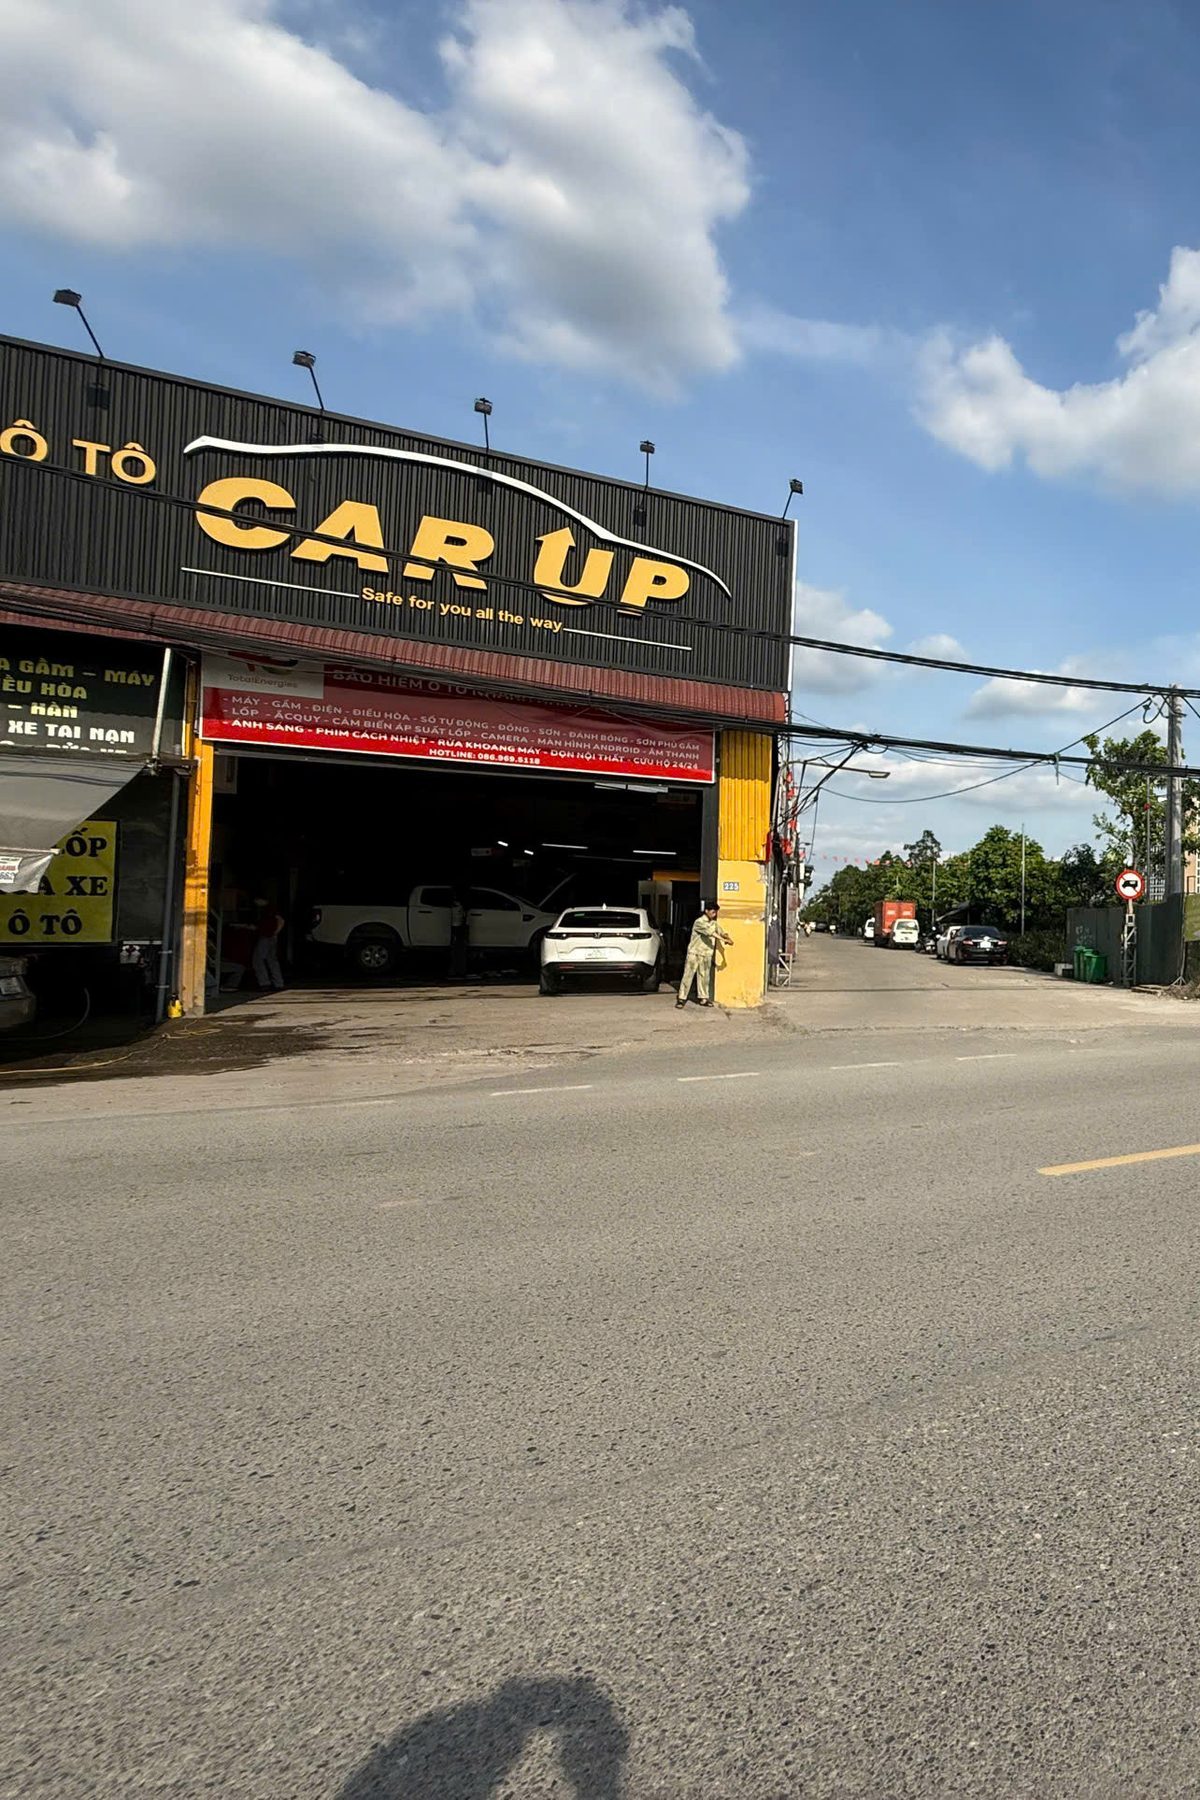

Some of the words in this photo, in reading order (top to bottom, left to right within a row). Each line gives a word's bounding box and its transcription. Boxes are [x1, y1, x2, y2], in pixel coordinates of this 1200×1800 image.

[0, 419, 48, 462] Ô
[72, 439, 157, 485] TÔ
[195, 476, 495, 591] CAR
[533, 526, 691, 617] UP
[361, 587, 403, 606] Safe
[408, 595, 435, 610] for
[439, 602, 472, 617] you
[475, 607, 494, 621] all
[497, 610, 524, 626] the
[529, 616, 563, 633] way
[18, 657, 75, 678] GẦM
[104, 669, 156, 687] MÁY
[40, 682, 87, 700] HÒA
[231, 696, 260, 706] MÁY
[30, 701, 78, 719] HÀN
[7, 720, 39, 736] XE
[45, 723, 82, 739] TAI
[89, 727, 136, 745] NẠN
[231, 718, 263, 730] ÁNH
[265, 721, 305, 733] SÁNG
[315, 727, 350, 738] PHIM
[351, 730, 389, 741] CÁCH
[390, 734, 428, 745] NHIỆT
[465, 741, 516, 753] KHOANG
[517, 746, 542, 756] MÁY
[576, 751, 596, 761] NỘI
[598, 753, 626, 764] THẤT
[671, 760, 699, 770] 24/24
[394, 722, 413, 732] ÁP
[480, 732, 529, 744] CAMERA
[592, 743, 641, 755] ANDROID
[665, 751, 700, 761] THANH
[428, 748, 477, 760] HOTLINE:
[54, 827, 108, 858] ỐP
[64, 876, 108, 897] XE
[8, 907, 31, 936] Ô
[40, 908, 83, 936] TÔ
